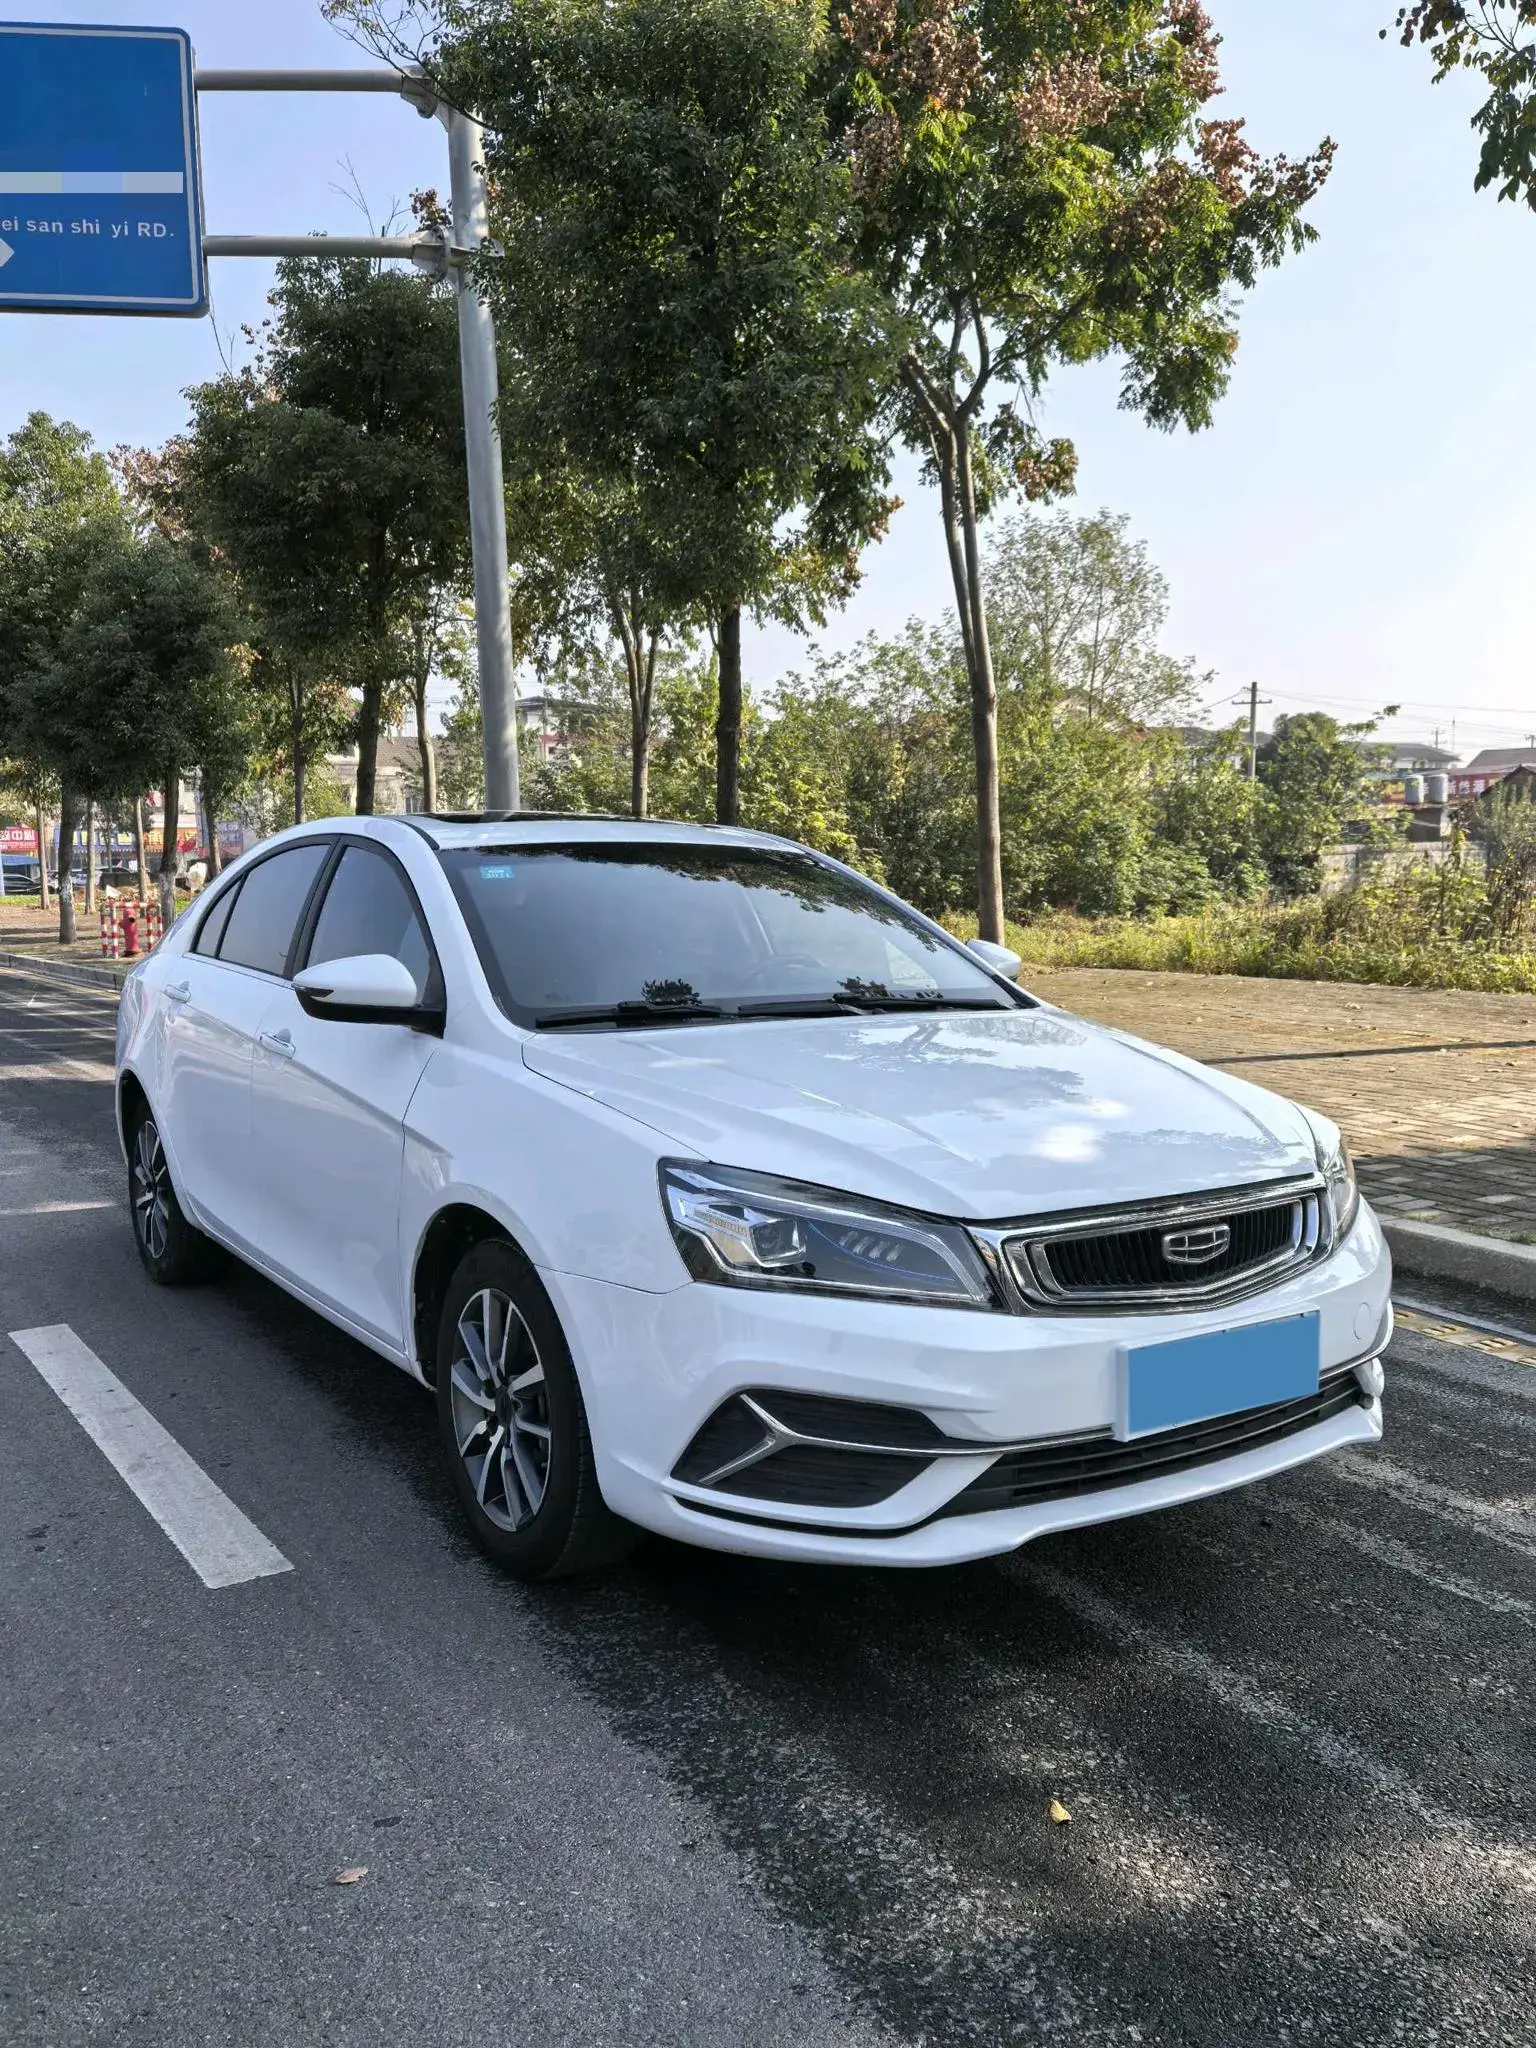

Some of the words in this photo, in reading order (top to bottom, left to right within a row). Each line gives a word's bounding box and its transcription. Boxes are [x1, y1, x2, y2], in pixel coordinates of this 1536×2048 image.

[26, 219, 63, 233] san
[71, 218, 100, 234] shi
[111, 220, 129, 238] yi
[137, 222, 174, 238] RD.
